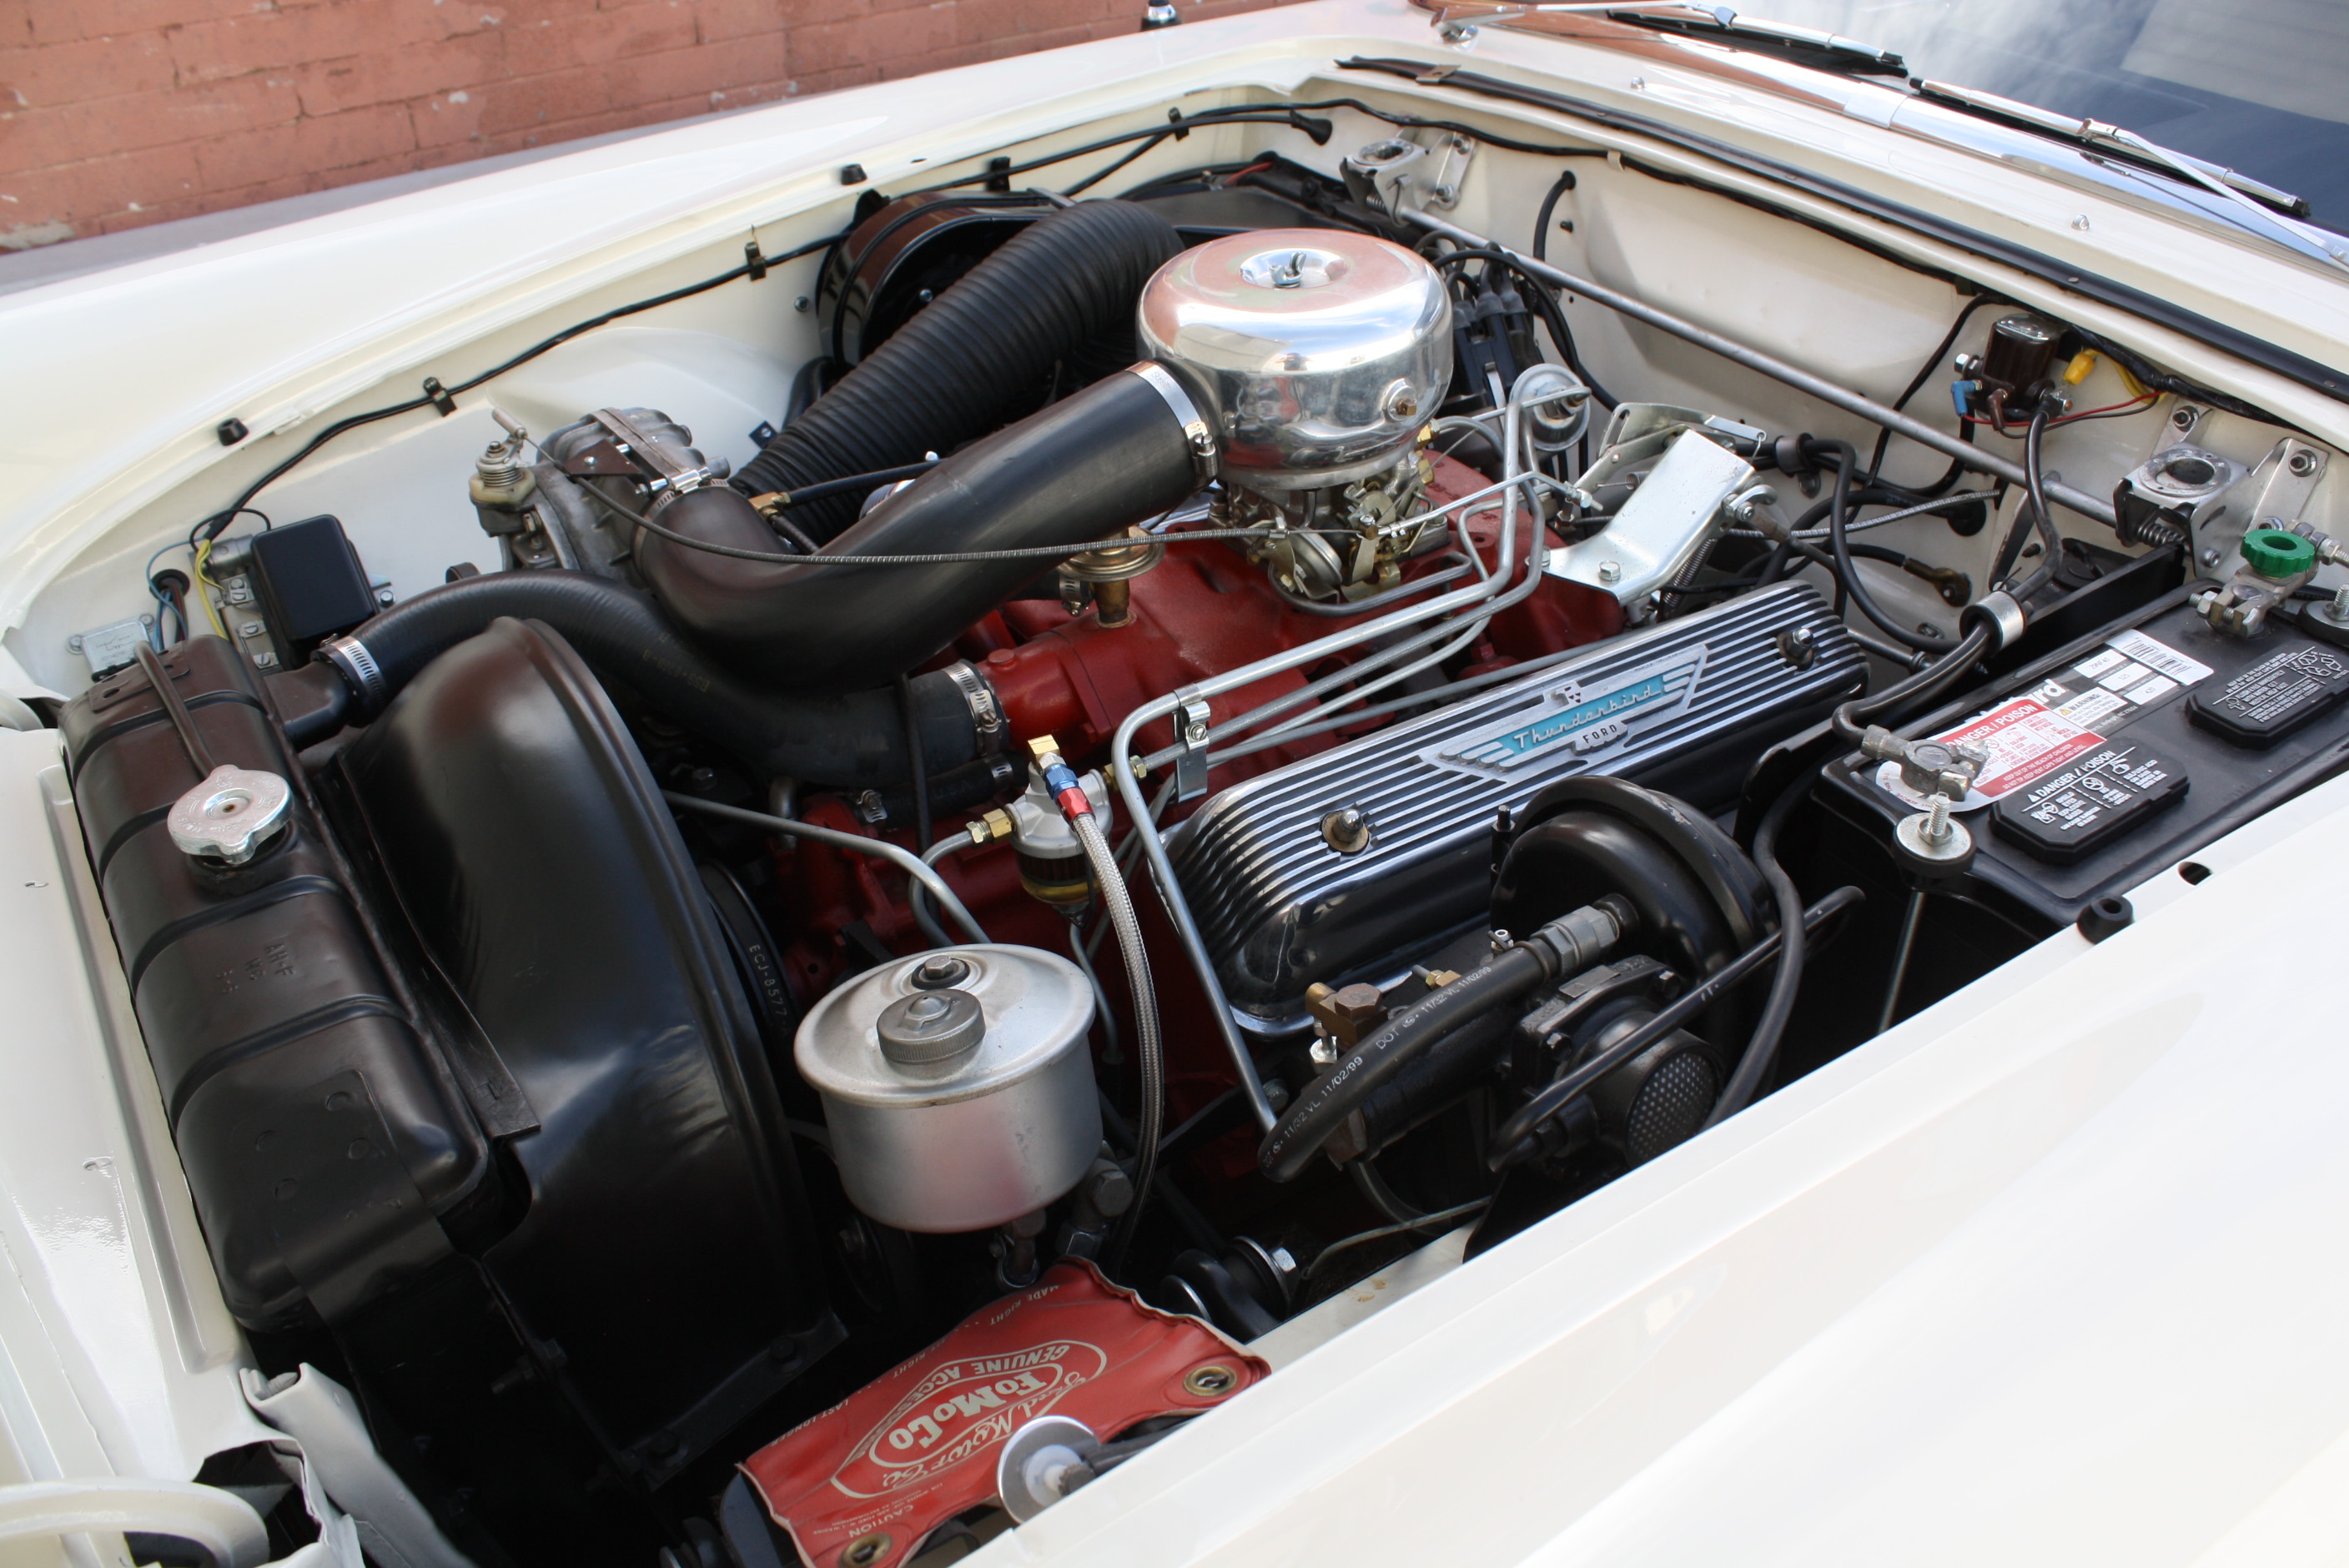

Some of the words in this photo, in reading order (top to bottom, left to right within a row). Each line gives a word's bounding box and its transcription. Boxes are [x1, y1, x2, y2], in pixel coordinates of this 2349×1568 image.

[1513, 684, 1662, 750] Thunderbird
[1995, 704, 2038, 726] POISON
[1582, 724, 1618, 744] FORD
[2035, 772, 2078, 797] DANGER
[2081, 751, 2116, 771] POISON
[1376, 1028, 1400, 1050] DOT
[1283, 1110, 1309, 1140] 11/32
[1305, 1099, 1322, 1116] VL
[1320, 1054, 1366, 1100] 11/02/99
[1028, 1284, 1059, 1300] MADE
[990, 1299, 1022, 1325] RIGHT
[893, 1353, 926, 1379] RIGHT
[971, 1344, 1070, 1375] GENUINE
[822, 1399, 849, 1419] LAST
[888, 1370, 1048, 1450] FoMoCo
[931, 1405, 1016, 1470] Motor
[848, 1505, 914, 1538] CAUTION
